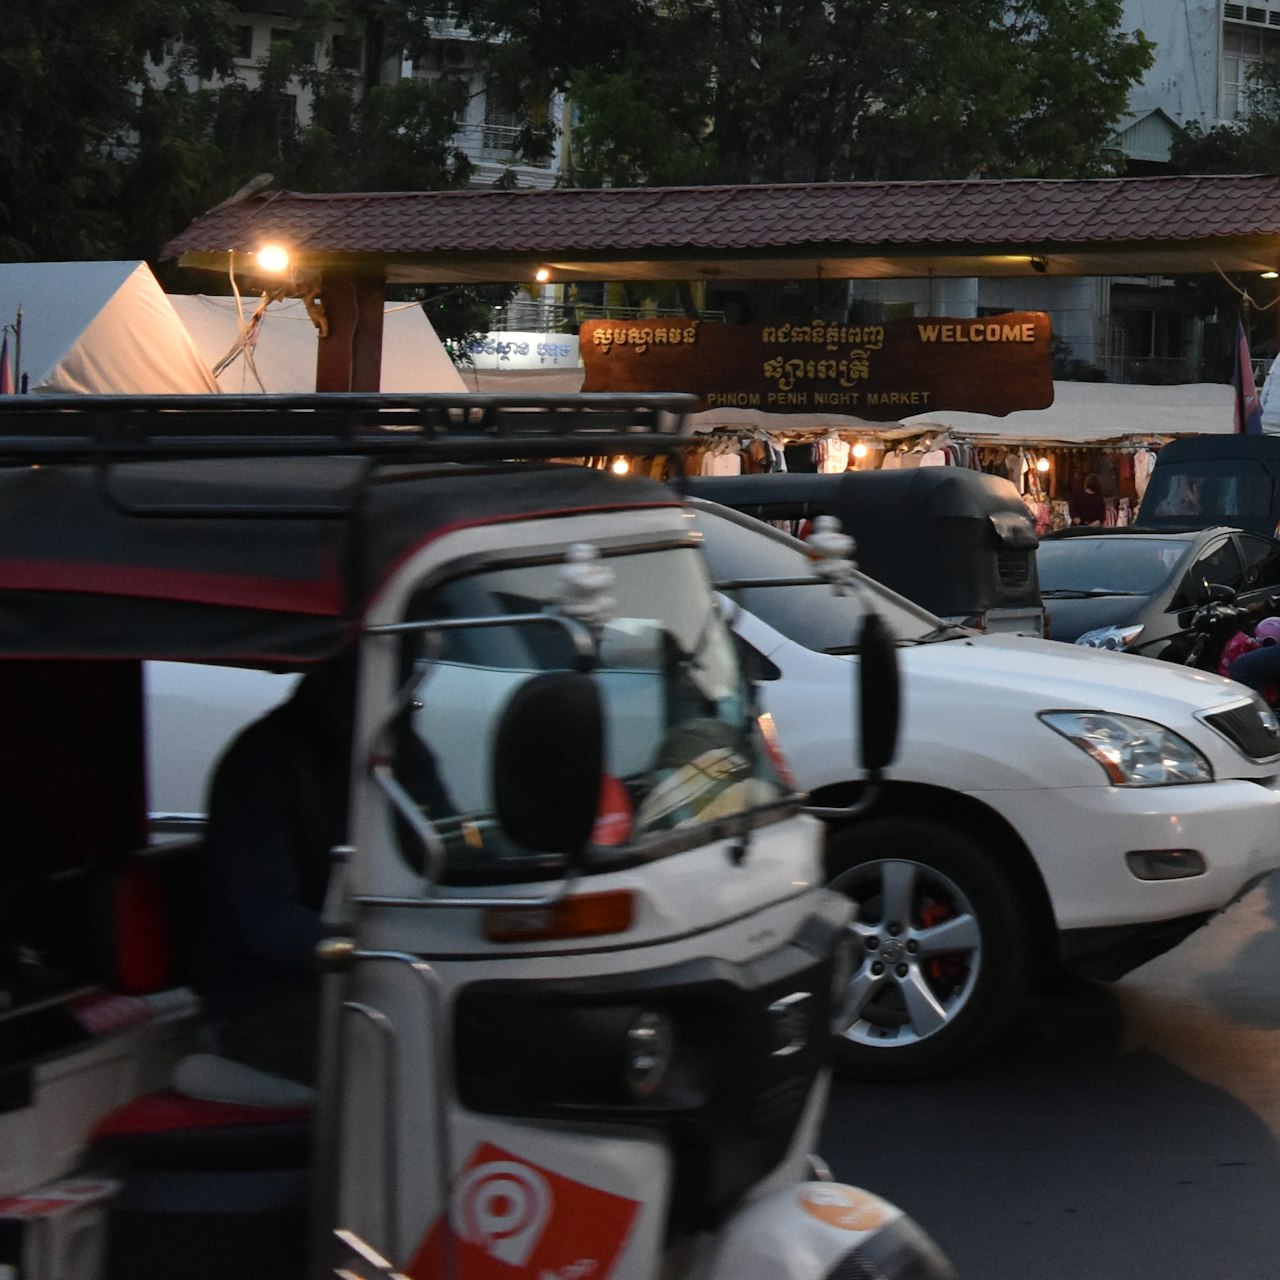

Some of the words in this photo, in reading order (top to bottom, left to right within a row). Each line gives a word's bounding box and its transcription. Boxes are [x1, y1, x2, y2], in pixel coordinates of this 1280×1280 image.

[918, 323, 1036, 343] WELCOME
[707, 392, 760, 406] PHNOM
[767, 392, 807, 405] PENH
[814, 392, 860, 405] NIGHT
[867, 391, 931, 405] MARKET
